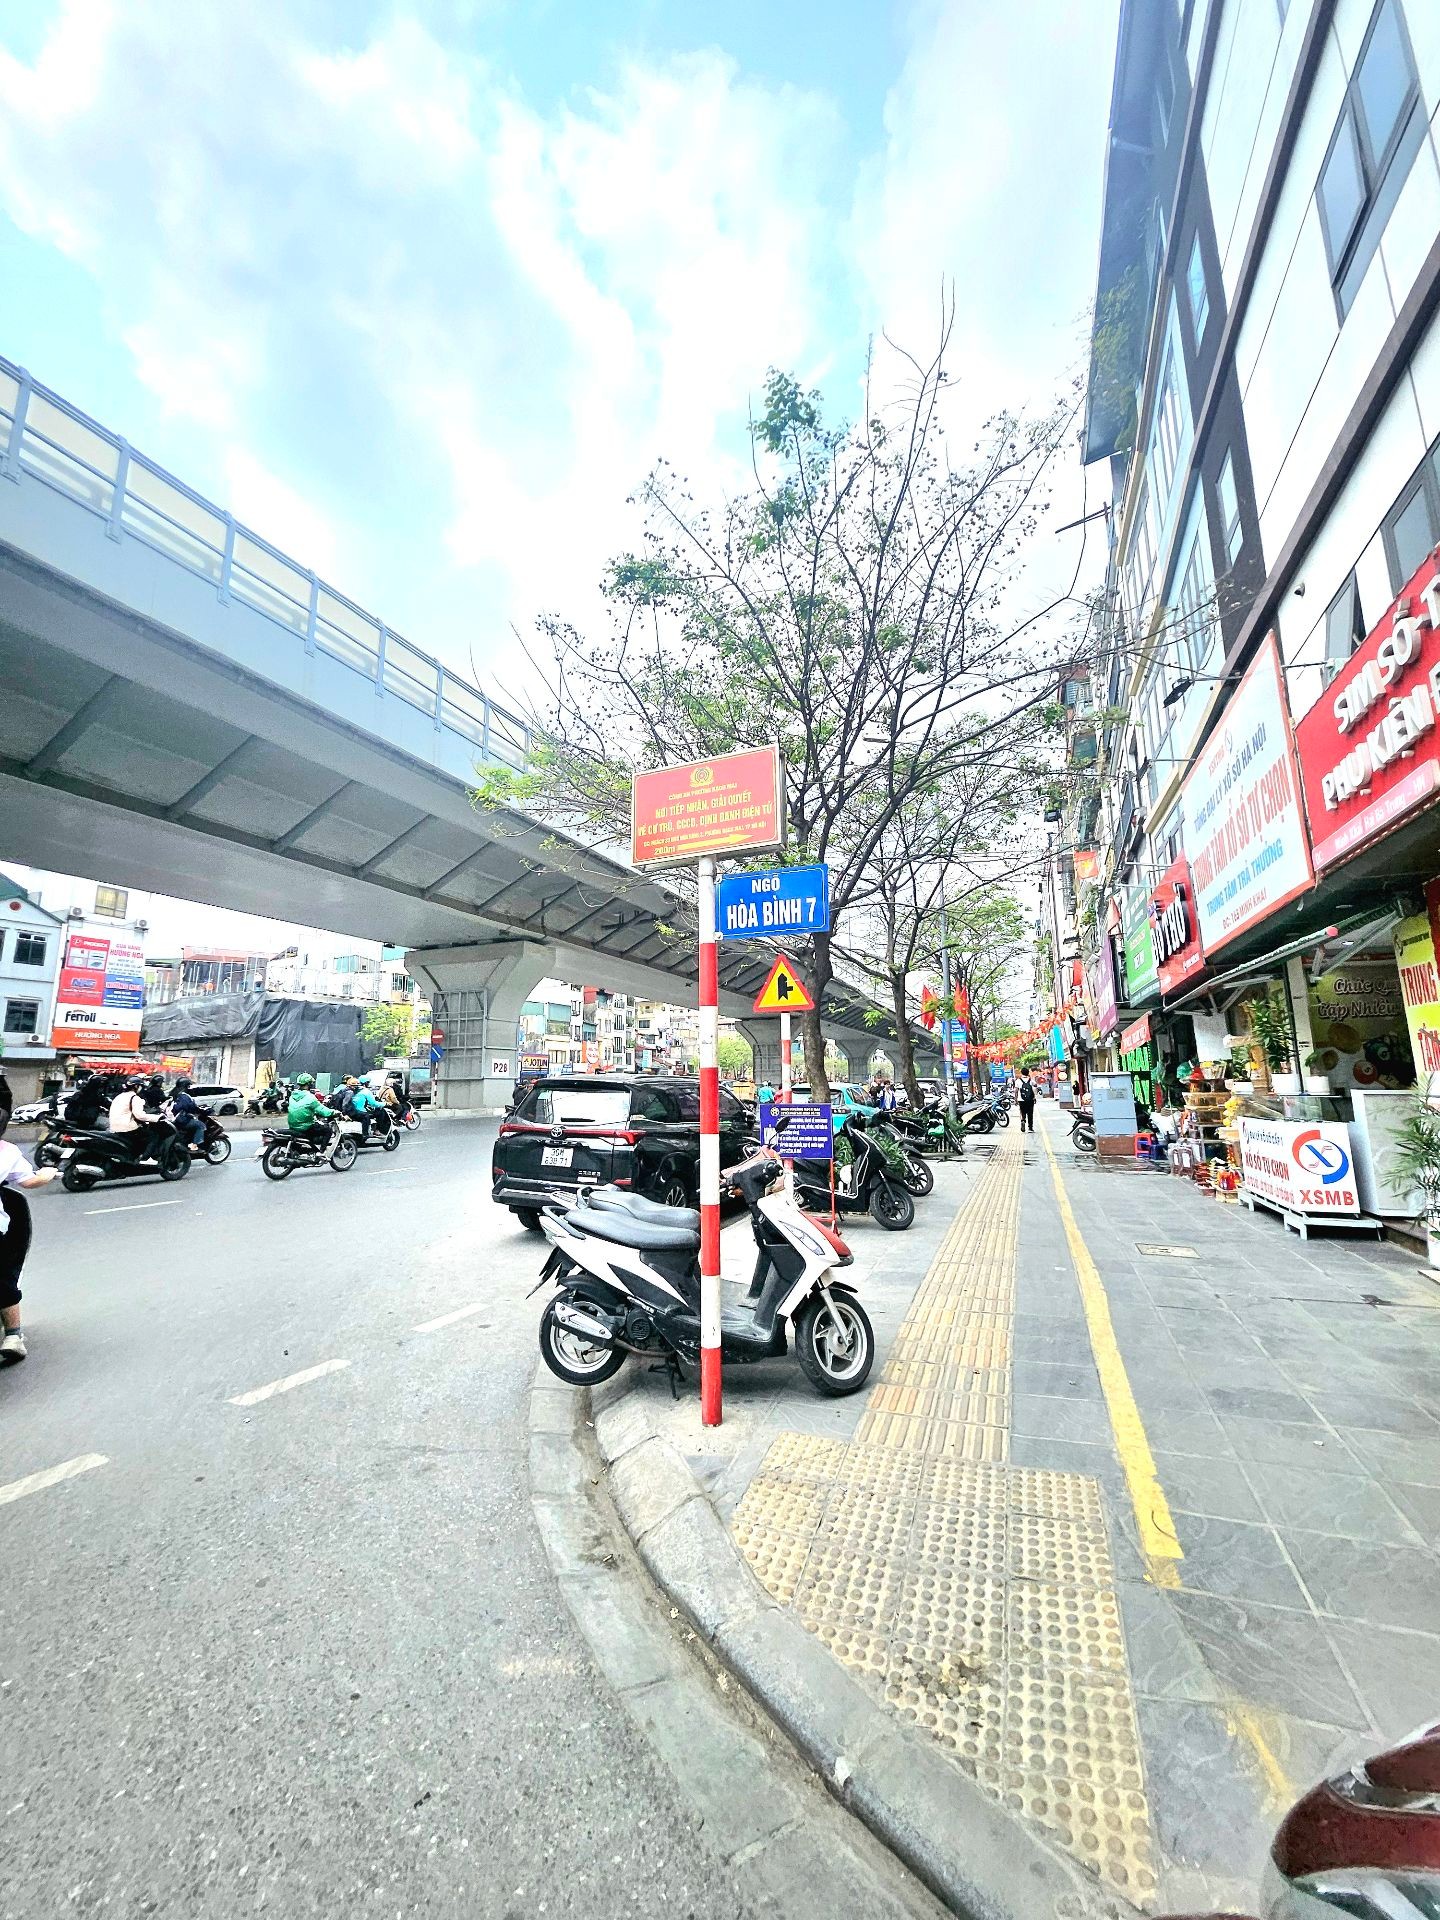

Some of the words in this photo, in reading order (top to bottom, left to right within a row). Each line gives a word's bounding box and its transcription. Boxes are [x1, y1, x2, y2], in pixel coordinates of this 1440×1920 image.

[1333, 660, 1386, 734] SIM
[1222, 762, 1232, 796] XỔ
[1232, 748, 1242, 783] SỐ
[1241, 739, 1252, 772] HÀ
[1252, 721, 1267, 760] NỘI
[1321, 742, 1373, 812] PHỤ
[1366, 684, 1435, 773] KIỆN
[648, 822, 658, 834] CƯ
[700, 814, 718, 828] ĐỊNH
[720, 810, 740, 823] DANH
[742, 806, 760, 819] ĐIỆN
[762, 802, 773, 815] TỬ
[670, 802, 684, 816] TIẾP
[711, 796, 726, 809] GIẢI
[728, 790, 752, 806] QUYẾT
[1193, 845, 1214, 895] TRUNG
[1210, 827, 1228, 877] TÂM
[1224, 798, 1238, 862] XỔ
[1236, 784, 1250, 851] SỐ
[1246, 779, 1263, 842] TỰ
[1260, 753, 1293, 823] CHỌN
[752, 873, 780, 894] NGÕ
[1206, 889, 1225, 917] TRUNG
[1224, 880, 1238, 902] TÂM
[1236, 859, 1252, 891] TRẢ
[1250, 837, 1284, 879] THƯỞNG
[726, 898, 758, 930] HÒA
[762, 894, 802, 927] BÌNH
[806, 896, 816, 923] 7
[1252, 887, 1268, 911] KHAI
[132, 951, 144, 959] NGA
[1334, 977, 1373, 996] Chúc
[1400, 961, 1439, 1007] TRUNG
[1299, 1189, 1355, 1206] XSMB
